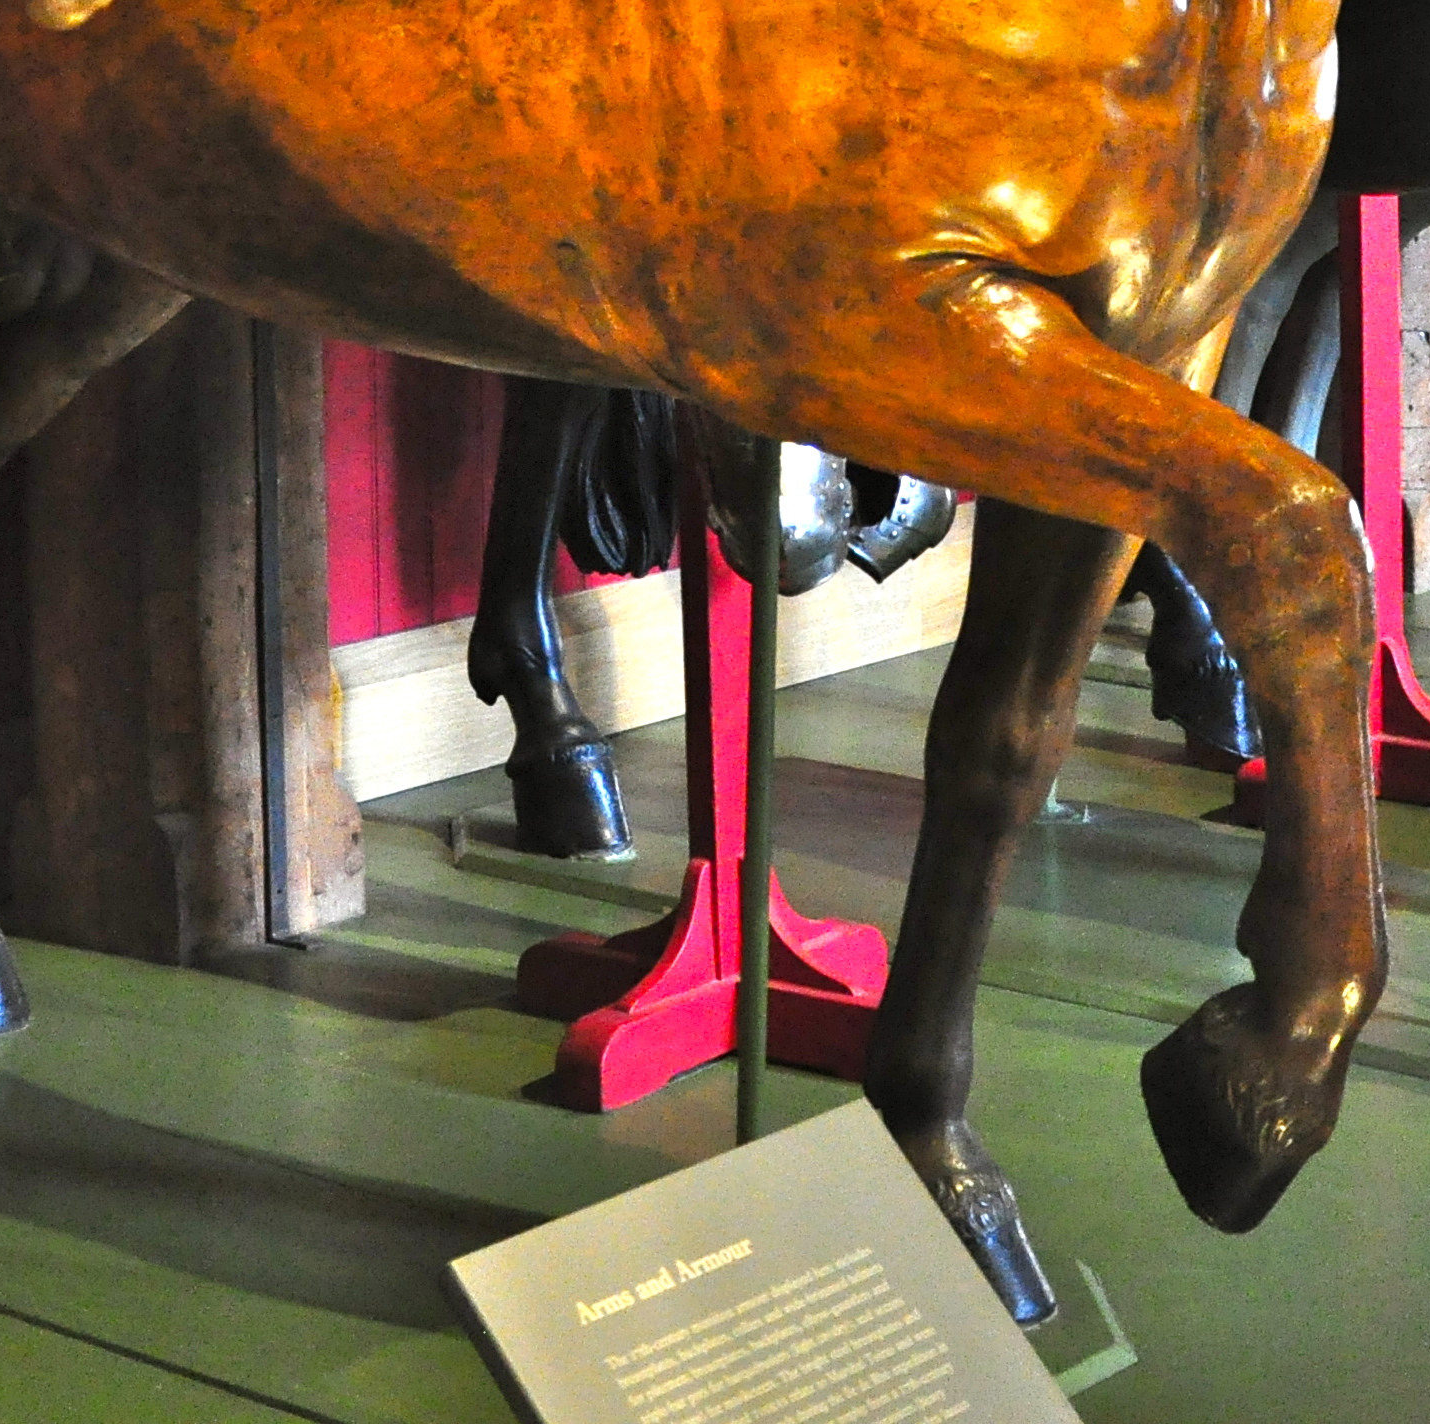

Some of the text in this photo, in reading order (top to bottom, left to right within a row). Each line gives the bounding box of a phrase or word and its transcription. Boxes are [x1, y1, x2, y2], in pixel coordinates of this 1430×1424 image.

[575, 1238, 753, 1325] Arms and Armour
